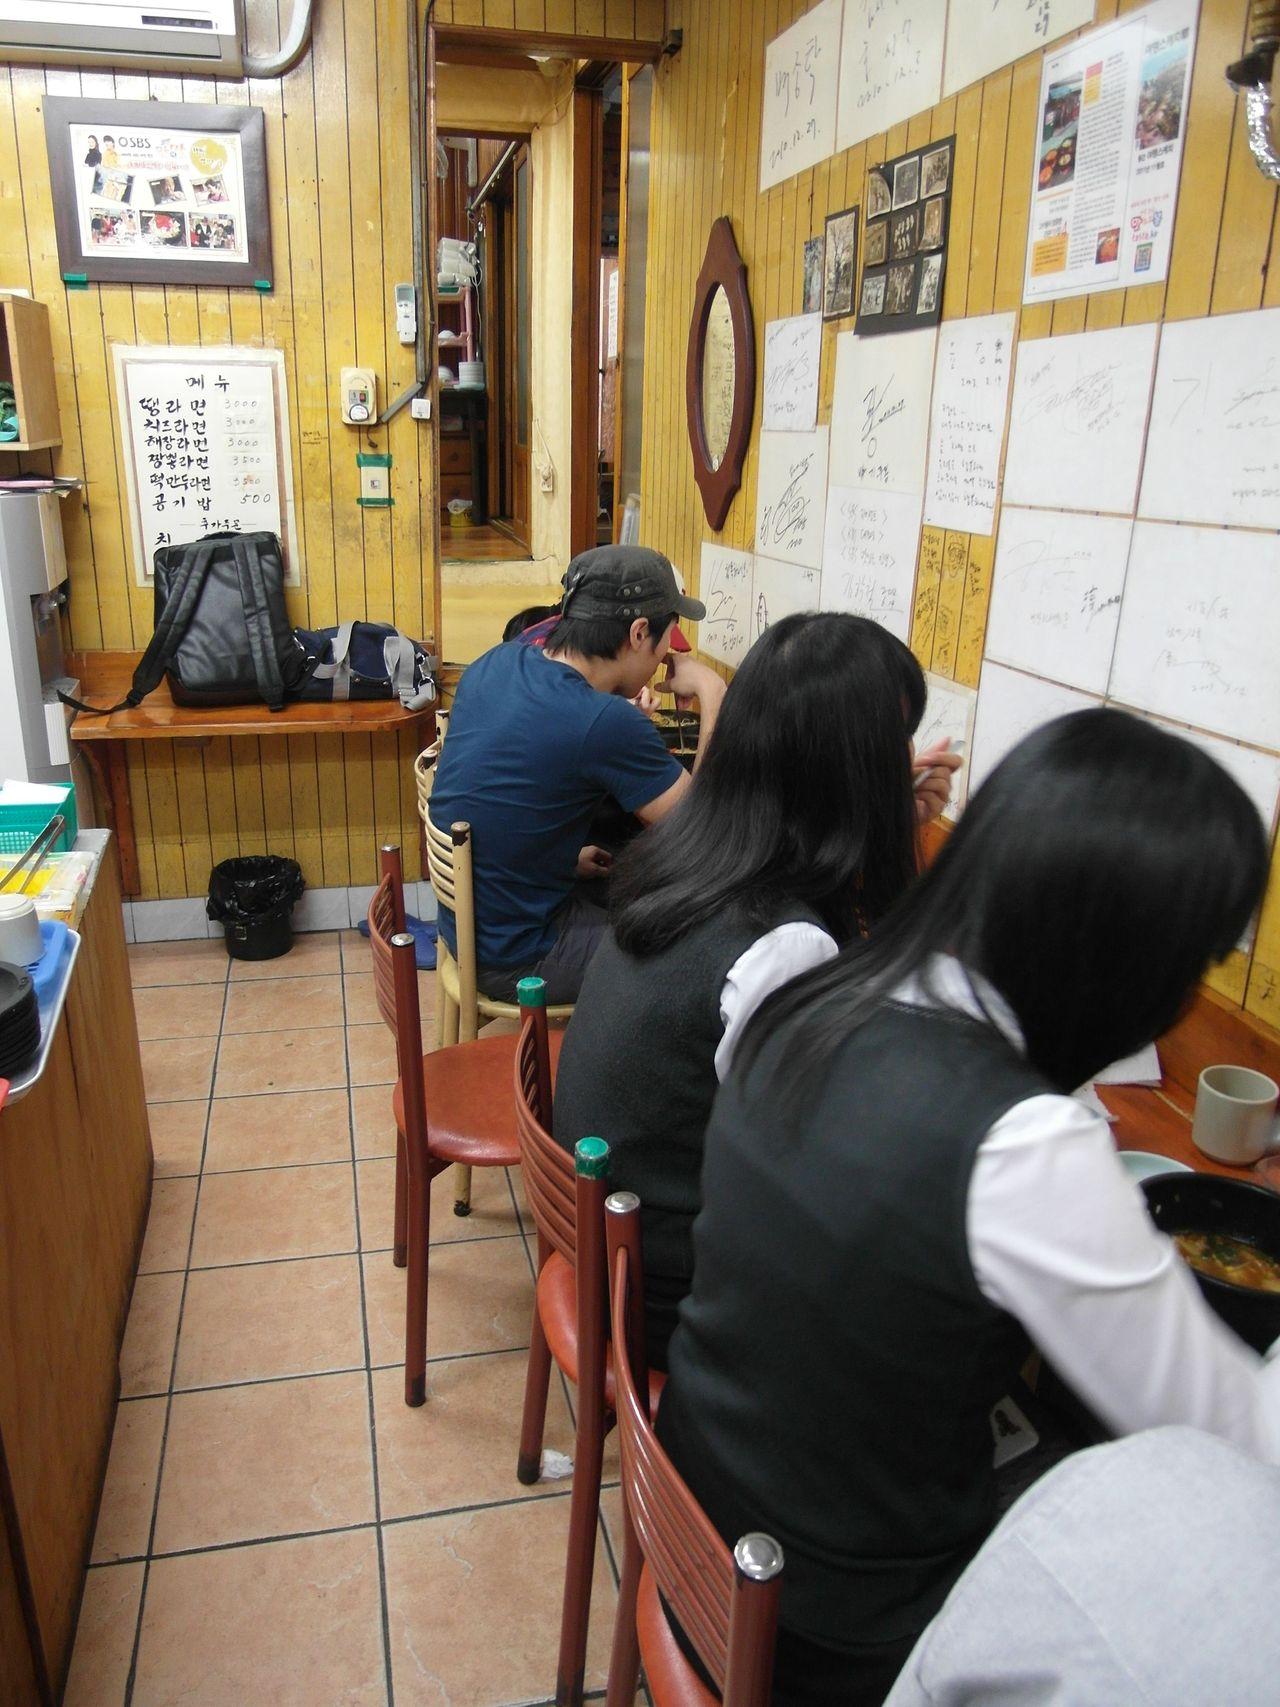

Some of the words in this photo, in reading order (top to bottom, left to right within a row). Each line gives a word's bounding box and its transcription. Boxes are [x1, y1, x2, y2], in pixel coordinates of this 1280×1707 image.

[224, 399, 258, 410] 3000
[143, 417, 207, 436] 치즈라면
[227, 438, 259, 448] 3000
[149, 473, 211, 494] 떡만두라면
[240, 493, 271, 505] 500
